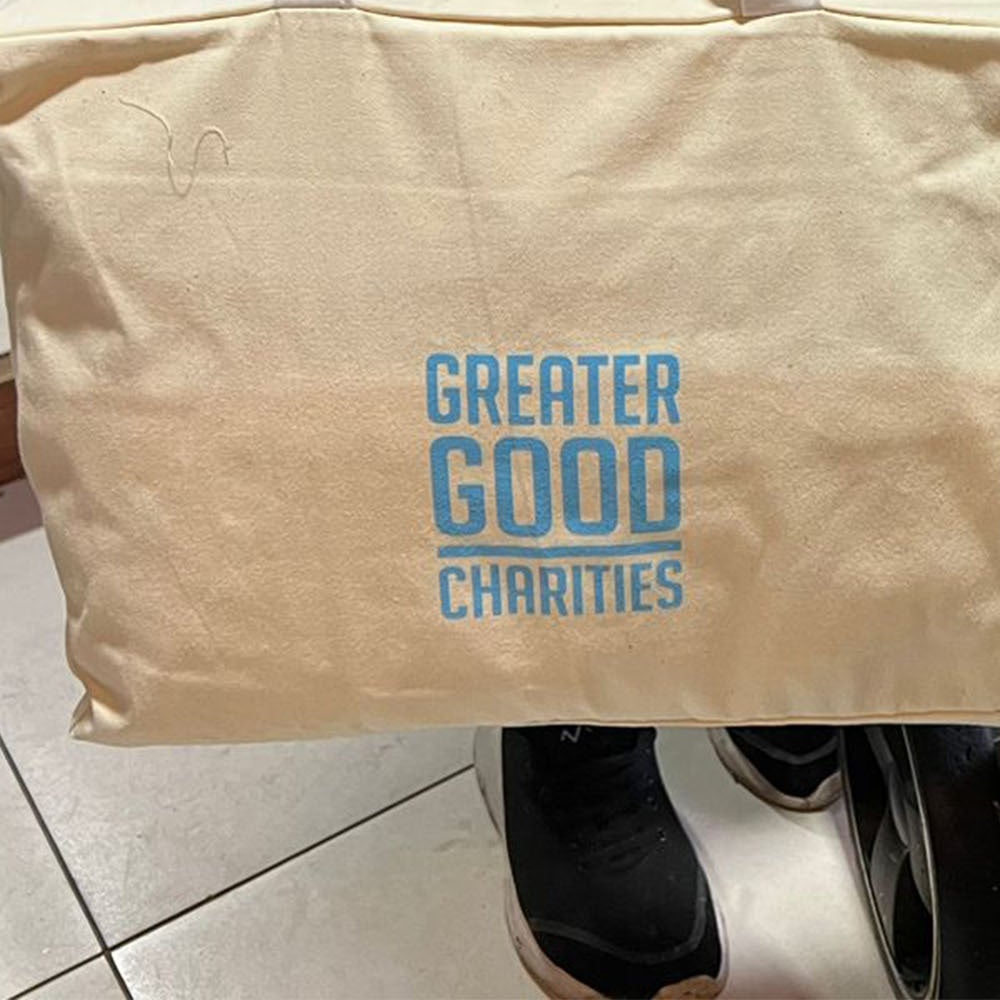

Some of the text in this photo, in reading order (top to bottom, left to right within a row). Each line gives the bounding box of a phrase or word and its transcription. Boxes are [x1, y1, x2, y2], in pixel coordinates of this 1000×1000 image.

[425, 353, 681, 426] GREATER
[429, 435, 682, 538] GOOD
[438, 558, 684, 620] CHARITIES
